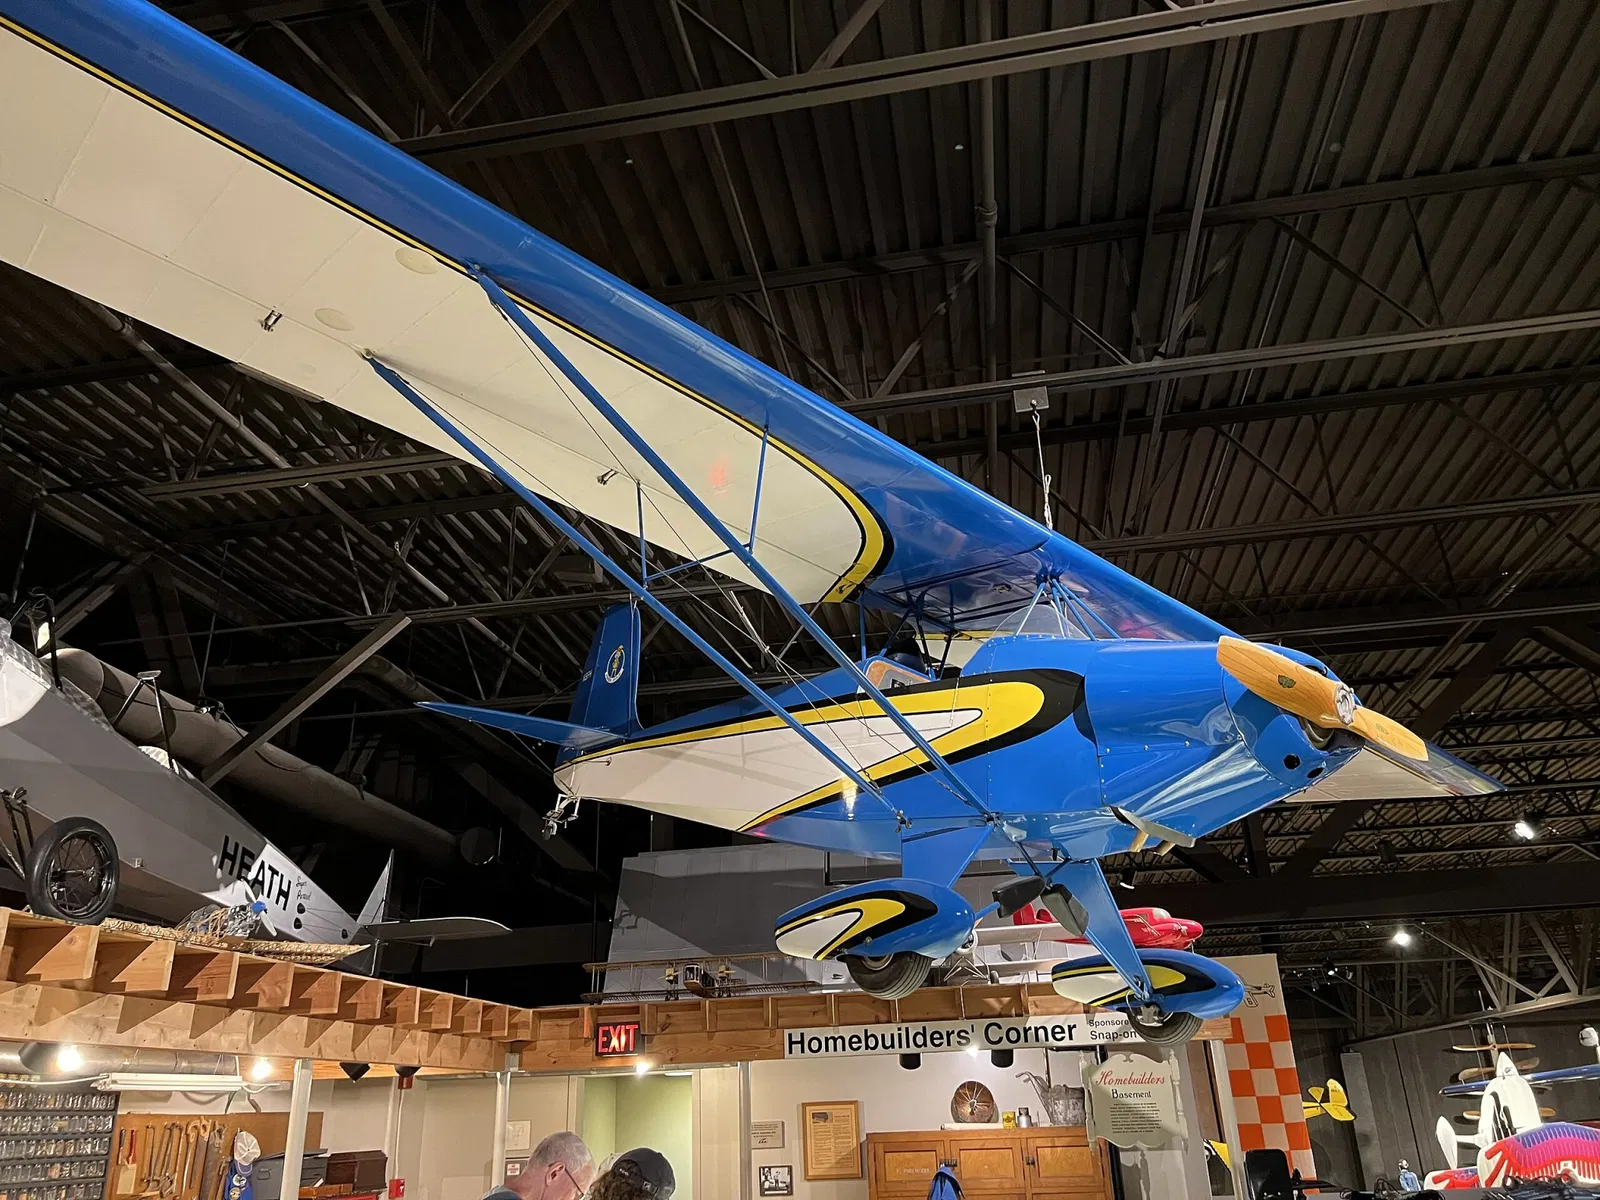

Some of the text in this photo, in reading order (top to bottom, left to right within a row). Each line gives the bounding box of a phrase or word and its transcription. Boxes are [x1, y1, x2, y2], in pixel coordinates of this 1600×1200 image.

[218, 834, 291, 911] HEATH
[1089, 1018, 1129, 1028] Sponsore
[598, 1024, 638, 1052] EXIT
[787, 1022, 1077, 1055] Homebuilders' Corner
[1090, 1029, 1137, 1042] Snap-on
[1096, 1070, 1165, 1086] Homebuilders
[1111, 1088, 1152, 1099] Basement
